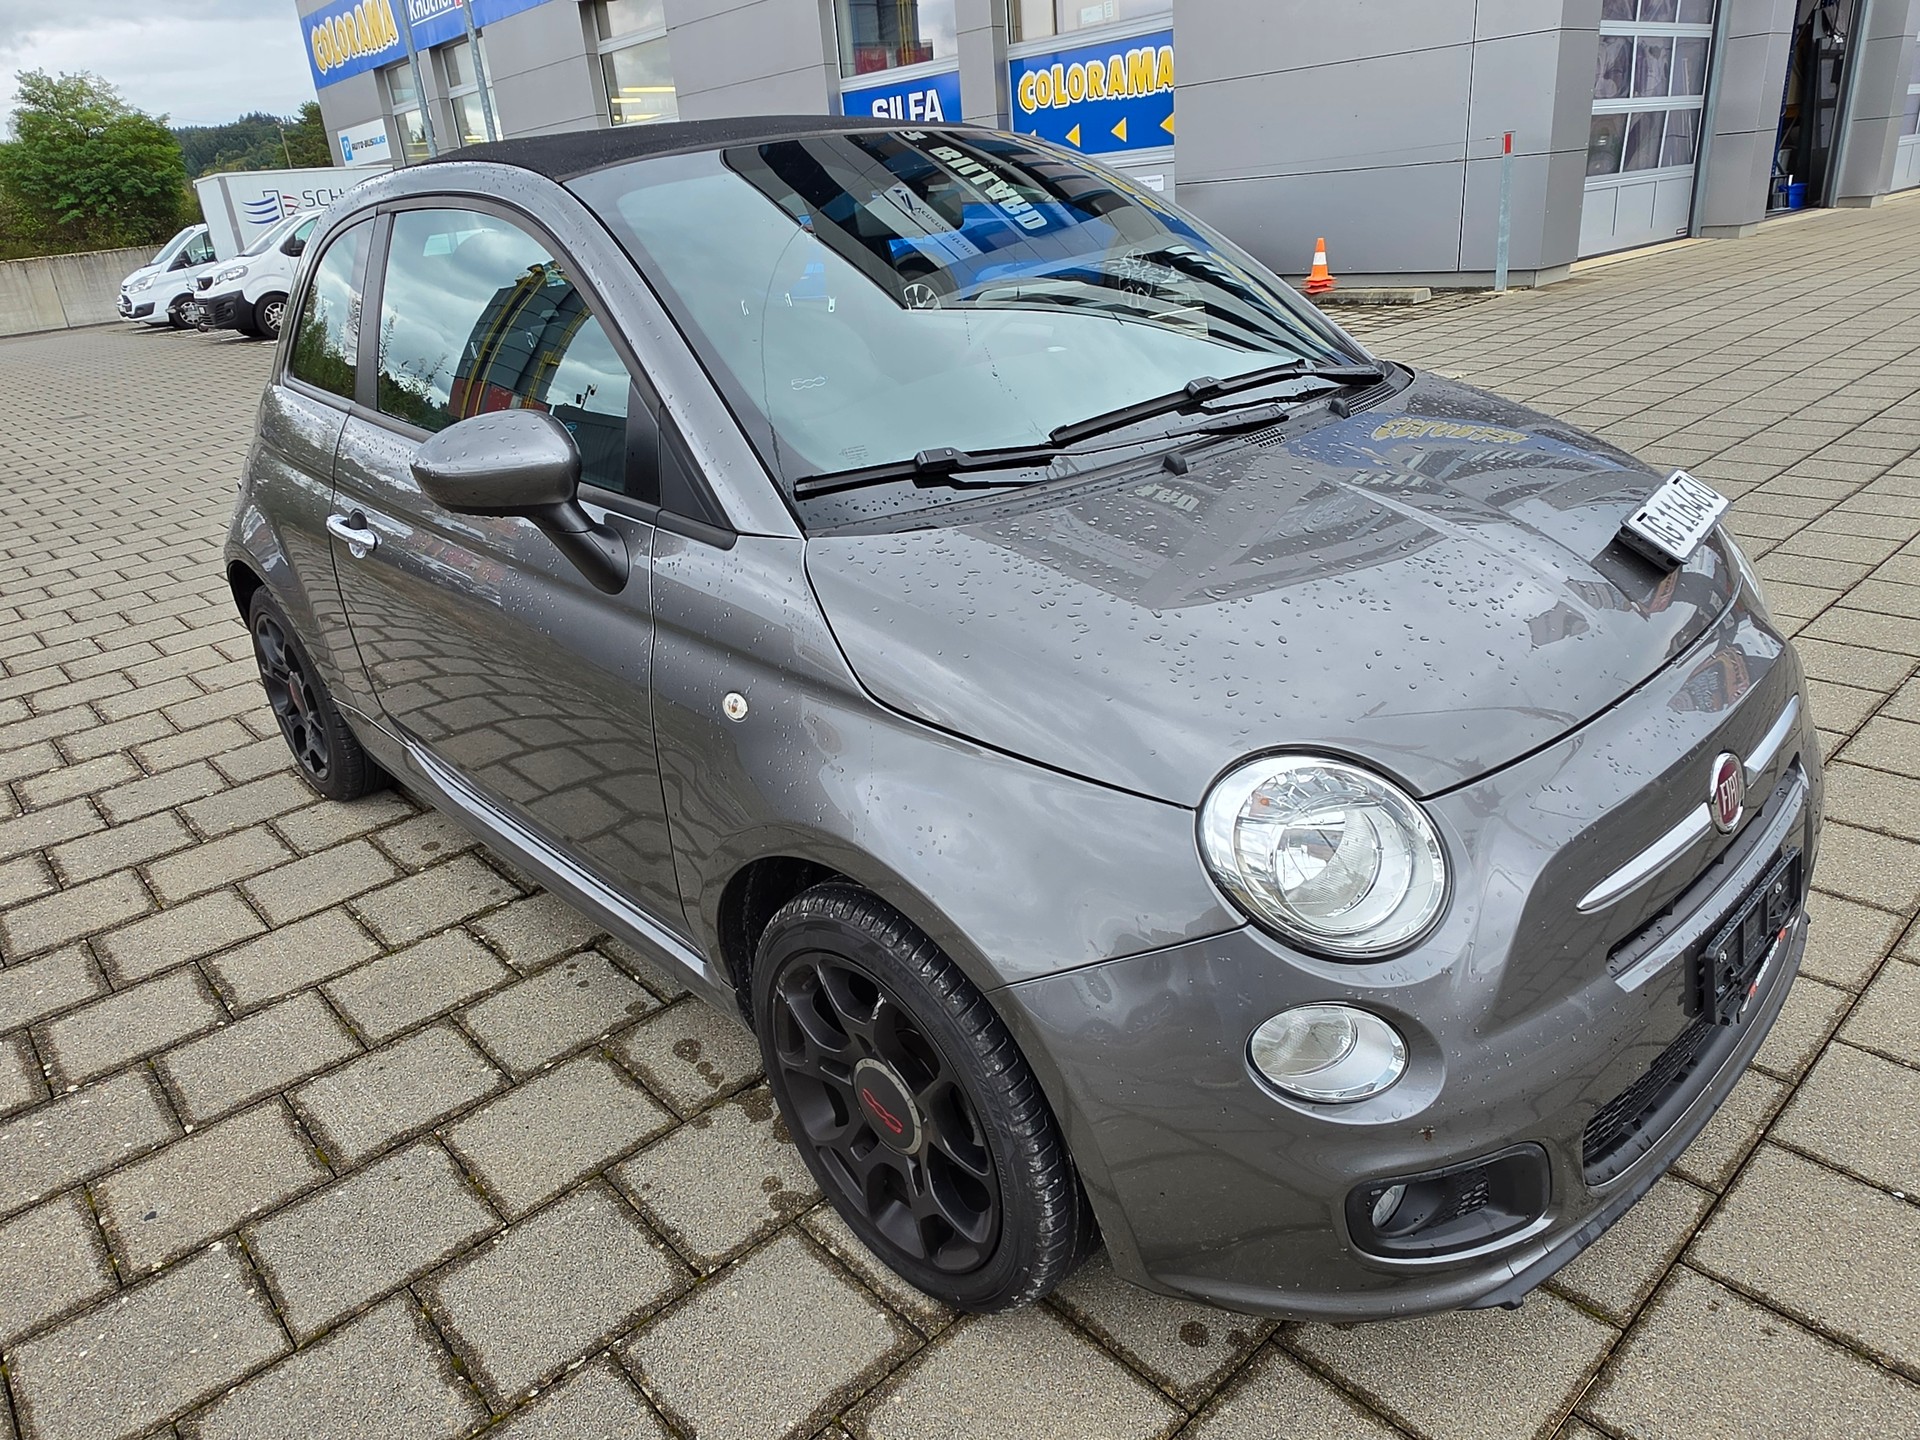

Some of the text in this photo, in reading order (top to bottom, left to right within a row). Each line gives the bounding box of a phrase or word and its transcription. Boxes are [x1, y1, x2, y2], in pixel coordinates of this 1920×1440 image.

[311, 0, 399, 76] COLORAMA
[408, 0, 453, 22] Knuc
[1018, 46, 1175, 115] COLORAMA
[1719, 770, 1740, 817] FIAT
